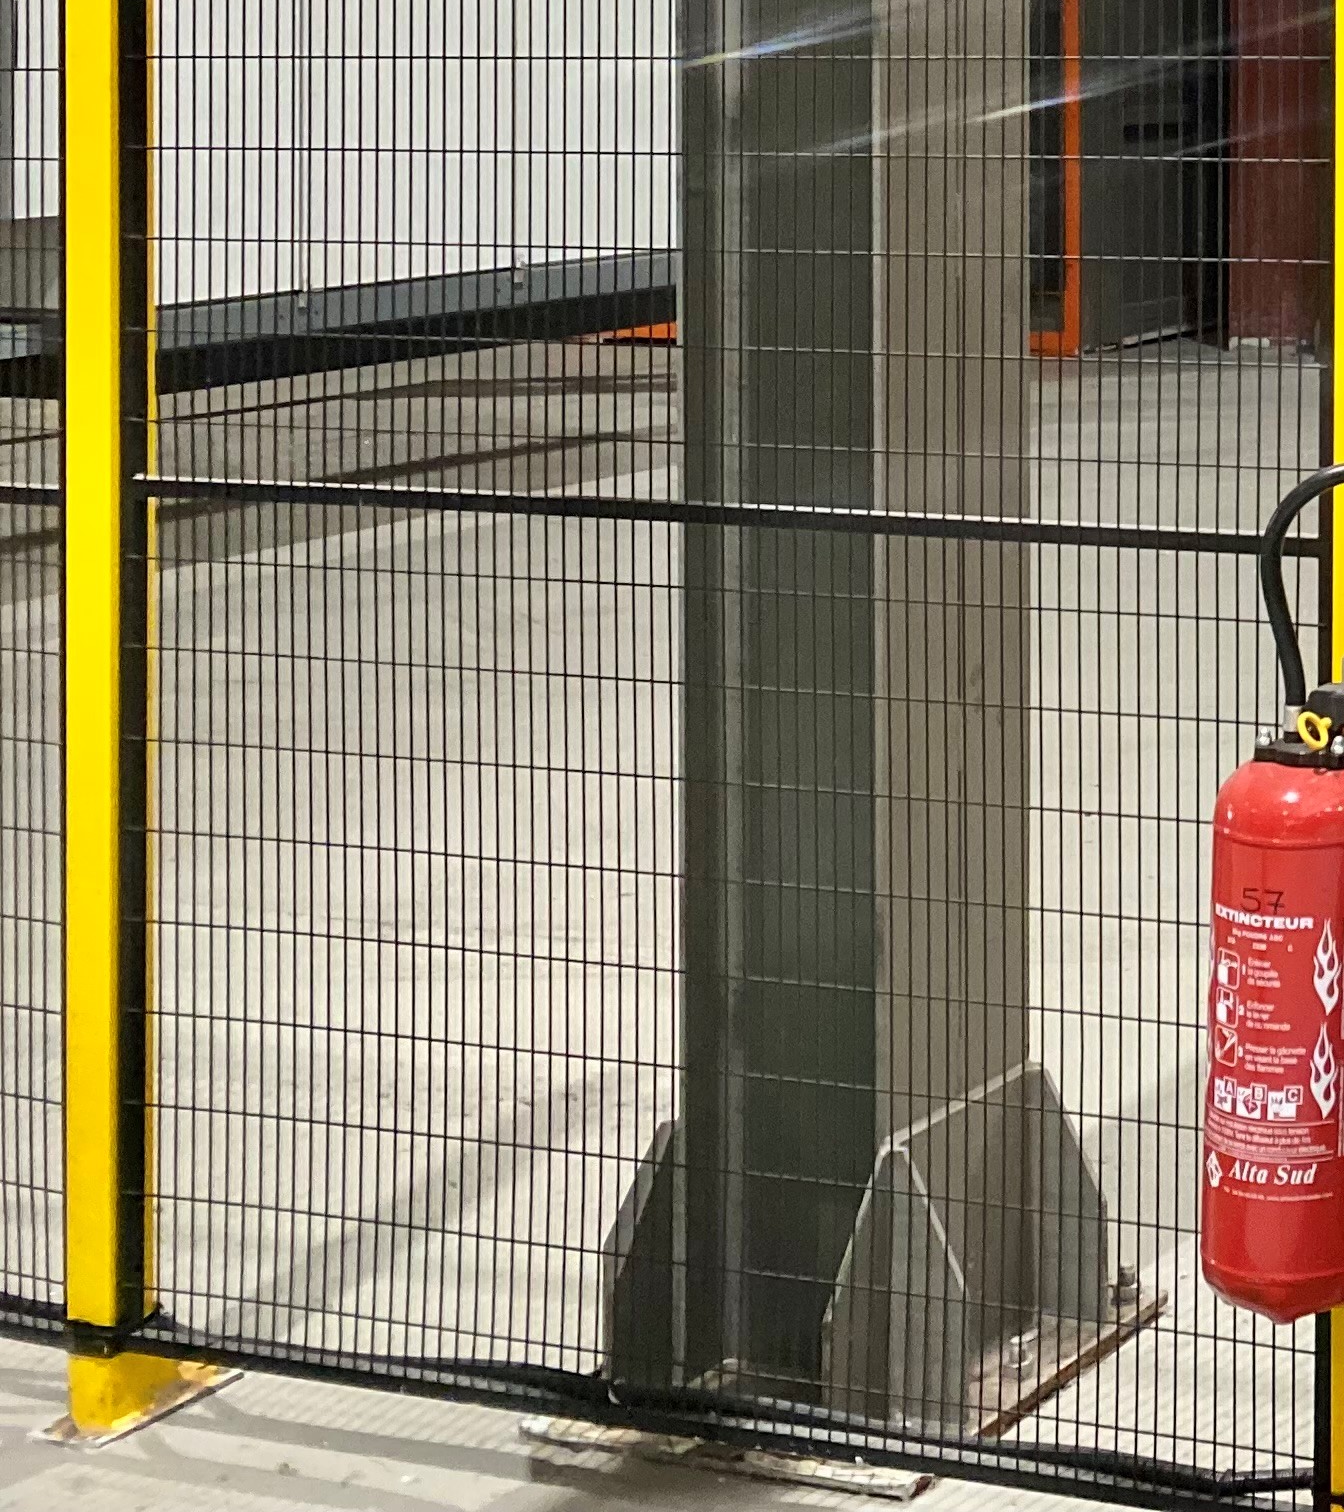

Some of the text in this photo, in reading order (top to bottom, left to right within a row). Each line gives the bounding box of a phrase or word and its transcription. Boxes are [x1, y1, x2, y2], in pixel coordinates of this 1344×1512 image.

[1241, 888, 1285, 915] 57
[1215, 903, 1314, 930] EXTINCTEUR
[1228, 1159, 1318, 1186] Alta Sud
